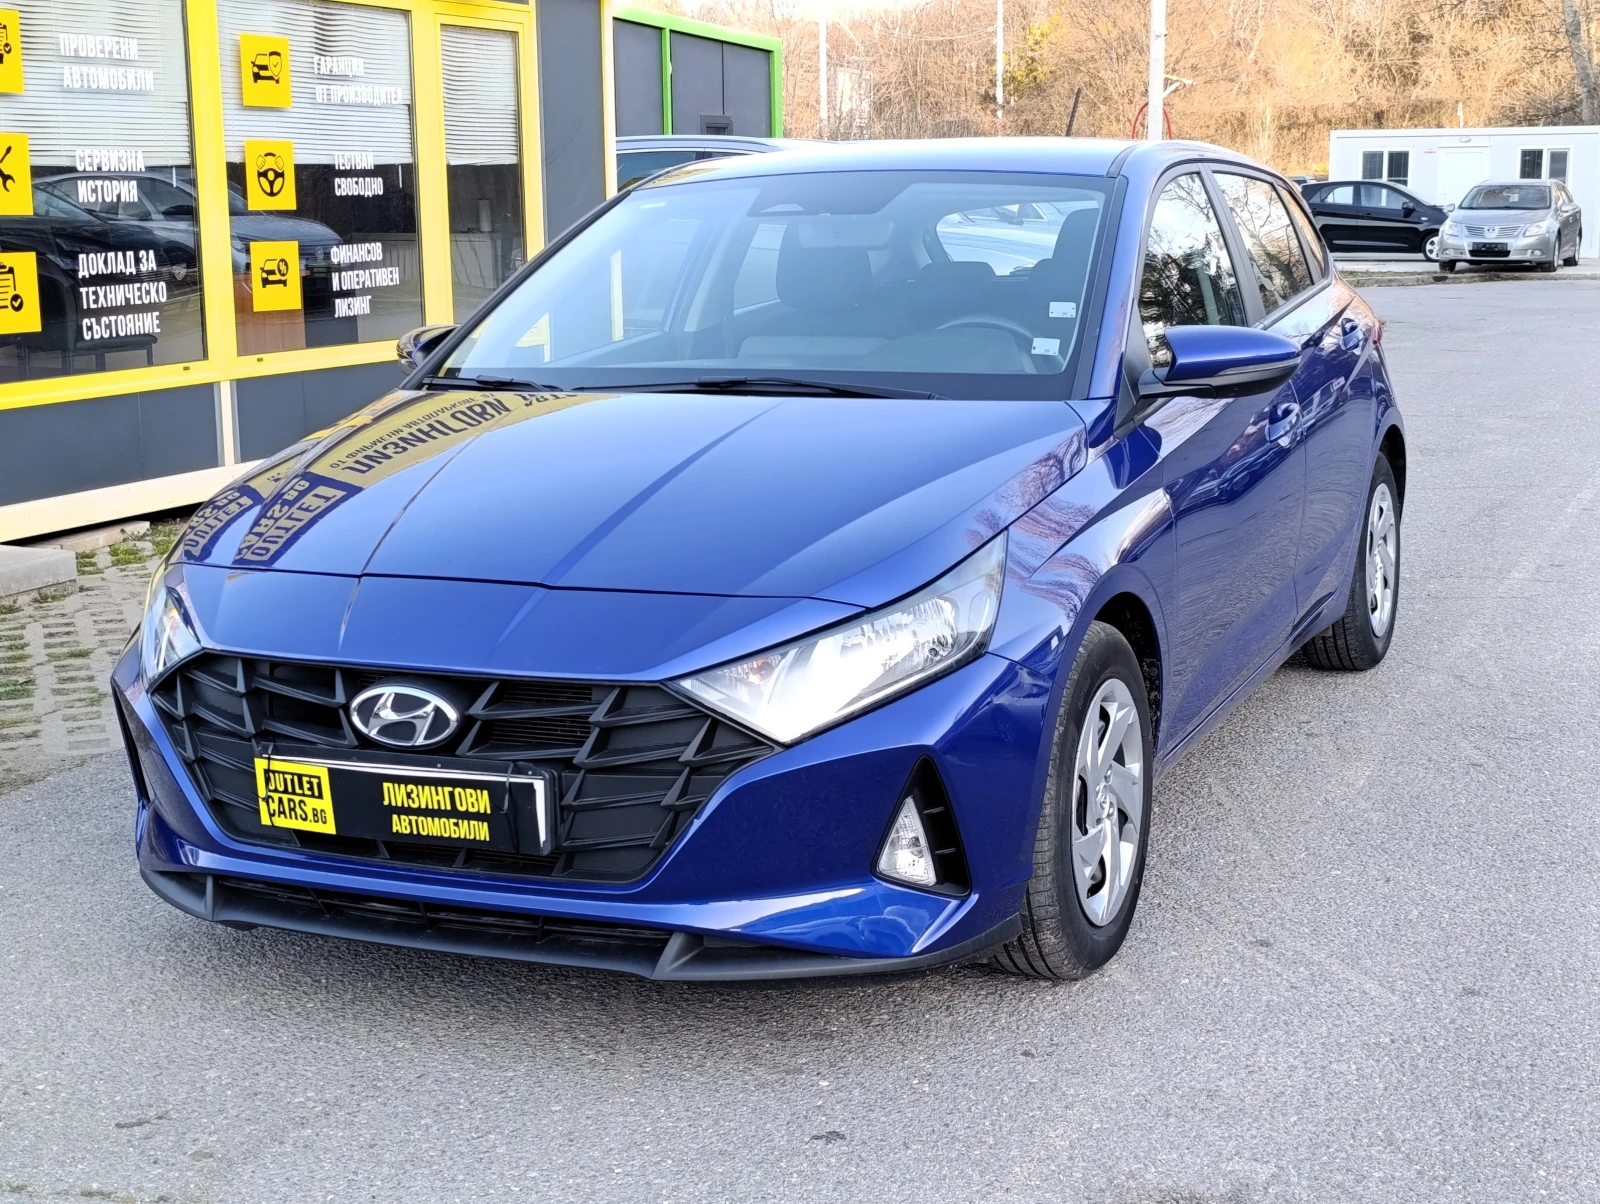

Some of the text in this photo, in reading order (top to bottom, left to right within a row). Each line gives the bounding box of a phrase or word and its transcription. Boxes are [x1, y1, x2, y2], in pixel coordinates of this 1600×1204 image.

[60, 33, 138, 60] ПРОВЕРЕНИ
[64, 66, 154, 91] АВТОМОБИЛИ
[316, 85, 328, 103] ОТ
[76, 149, 145, 171] СЕРВИЗНА
[334, 149, 374, 170] ТЕСТВАЙ
[77, 180, 138, 202] ИСТОРИЯ
[334, 177, 383, 197] СВОБОДНО
[78, 249, 157, 278] ДОКЛАД ЗА
[330, 242, 383, 264] ФИНАНСОВ
[332, 266, 400, 291] И ОПЕРАТИВЕН
[80, 281, 167, 309] ТЕХНИЧЕСКО
[334, 295, 372, 318] ЛИЗИНГ
[82, 312, 161, 340] СЪСТОЯНИЕ
[382, 782, 491, 814] ЛИЗИНГОВИ
[392, 814, 490, 842] АВТОМОБИЛИ
